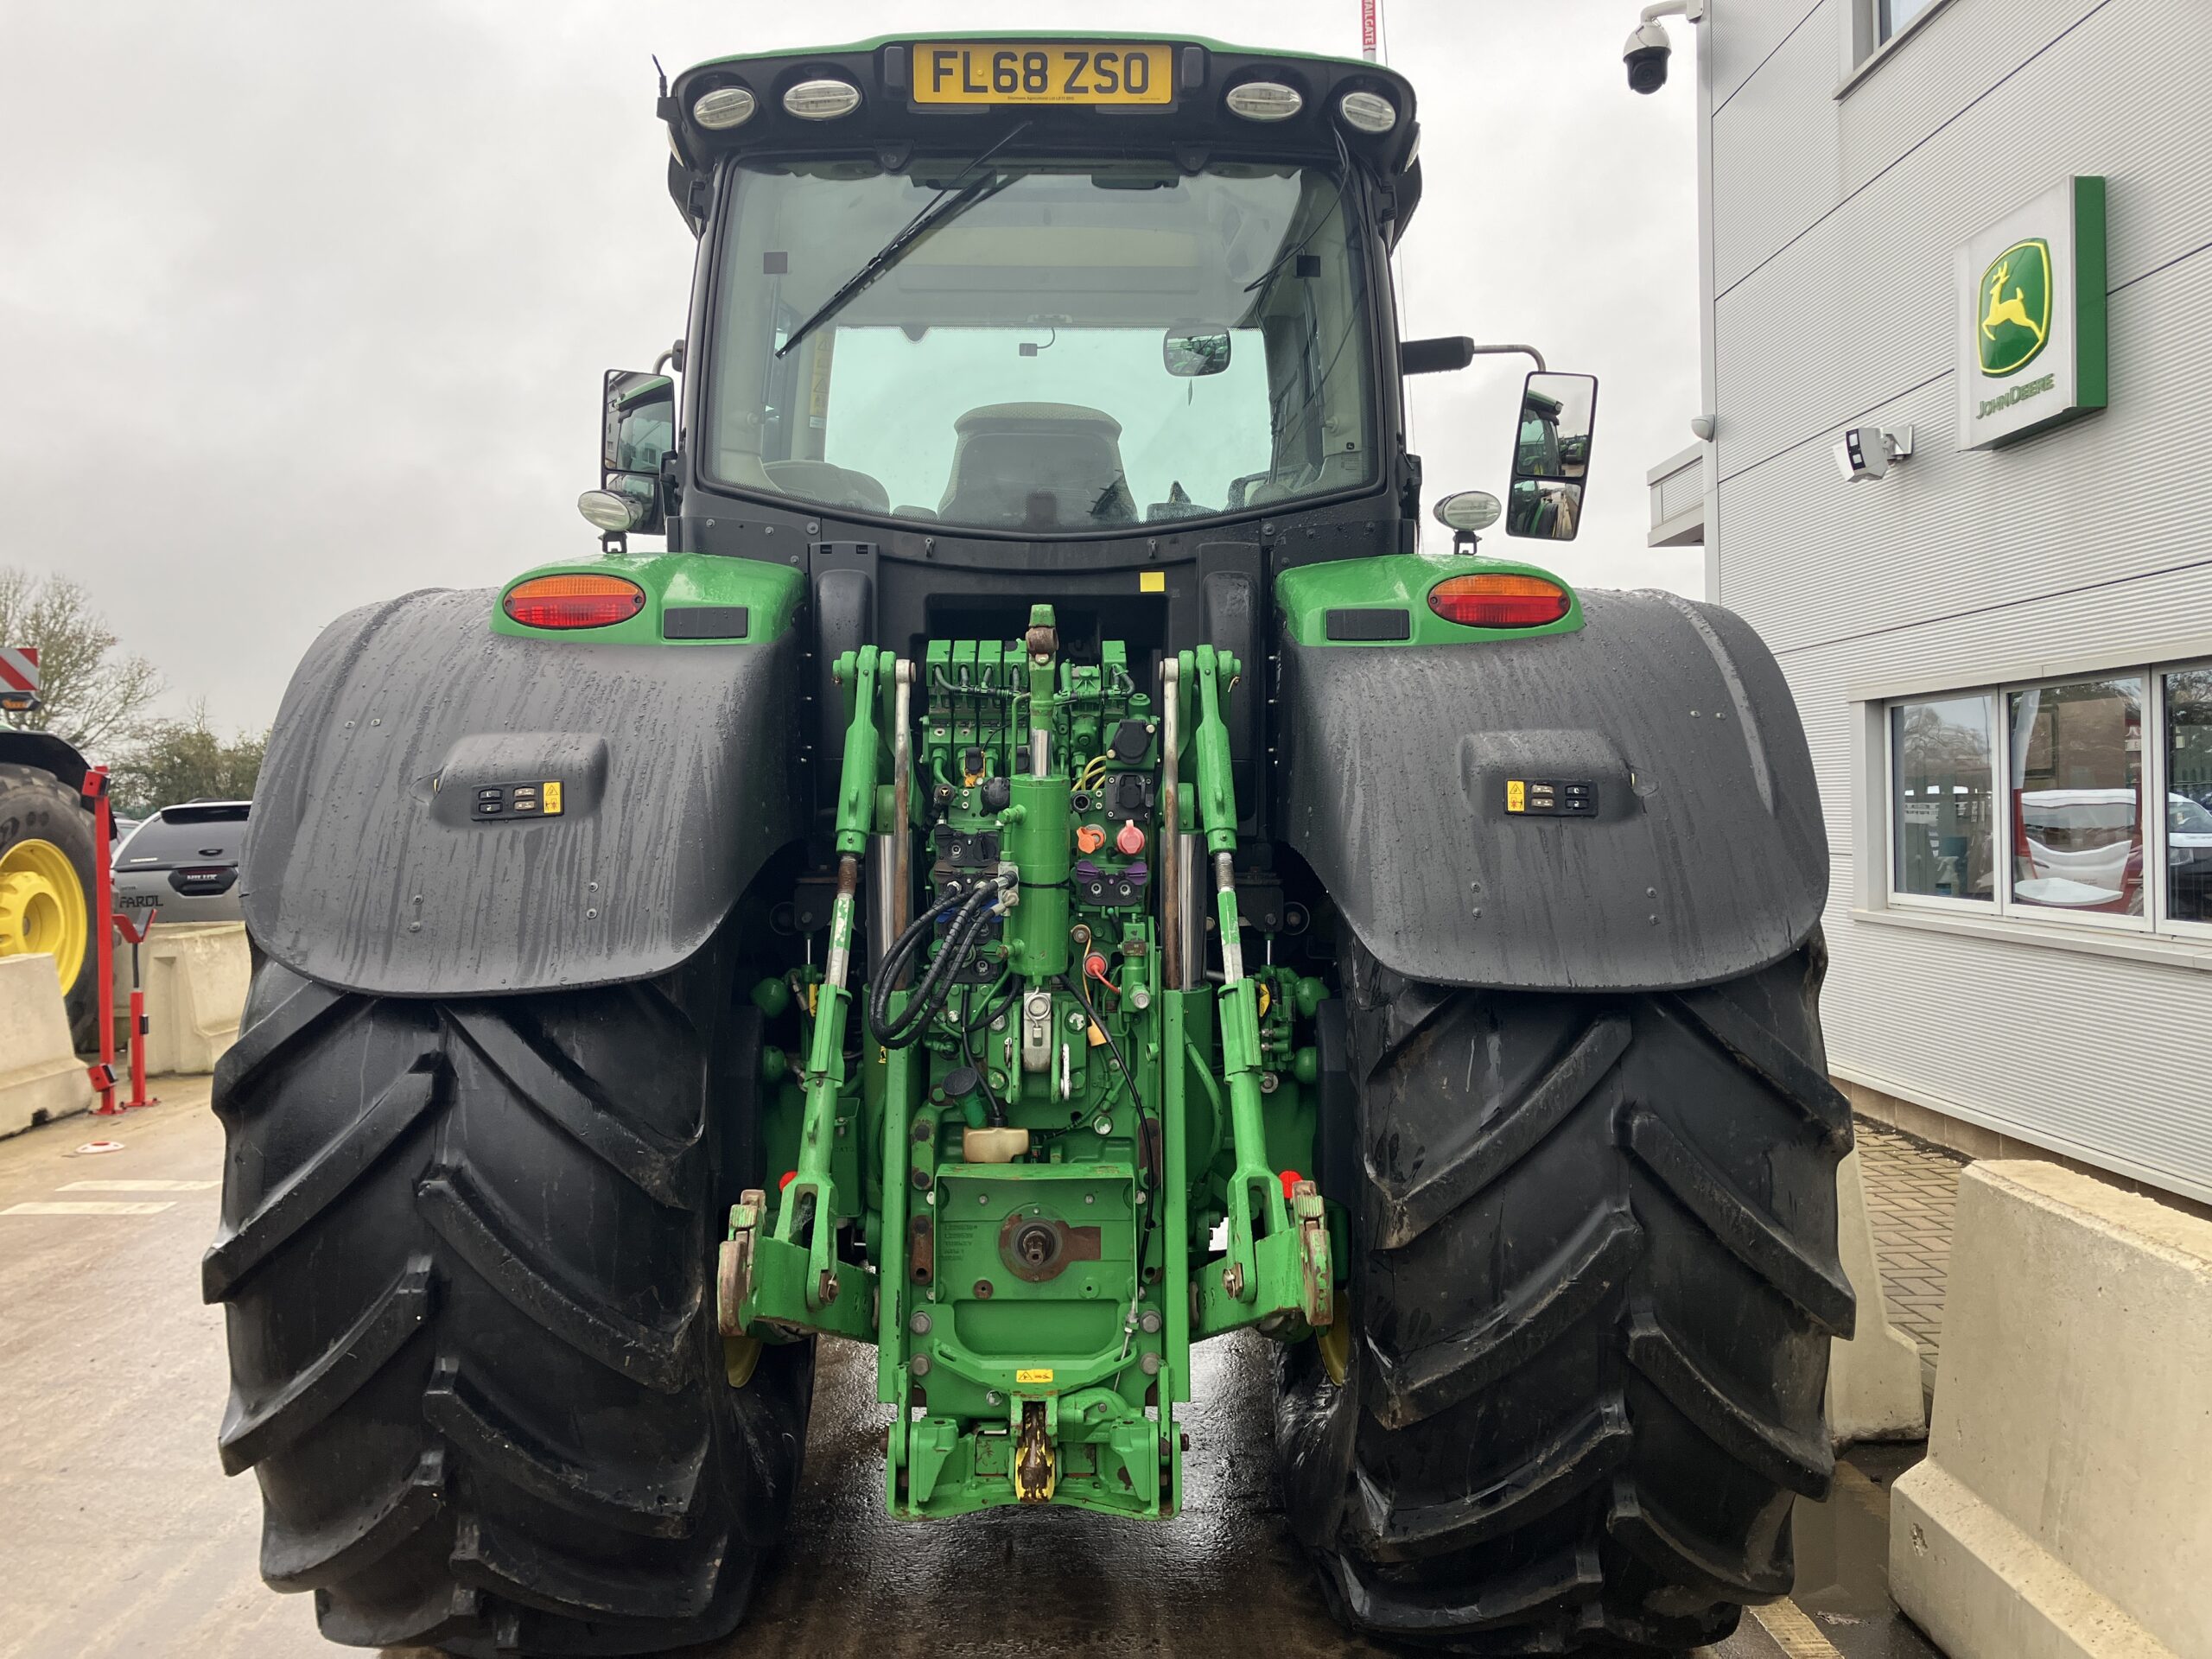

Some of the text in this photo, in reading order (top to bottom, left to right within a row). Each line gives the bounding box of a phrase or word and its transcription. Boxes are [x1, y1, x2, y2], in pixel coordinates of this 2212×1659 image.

[932, 51, 1150, 94] FL68 ZSO
[1976, 372, 2055, 419] JOHN DEERE
[119, 895, 164, 908] FAROL
